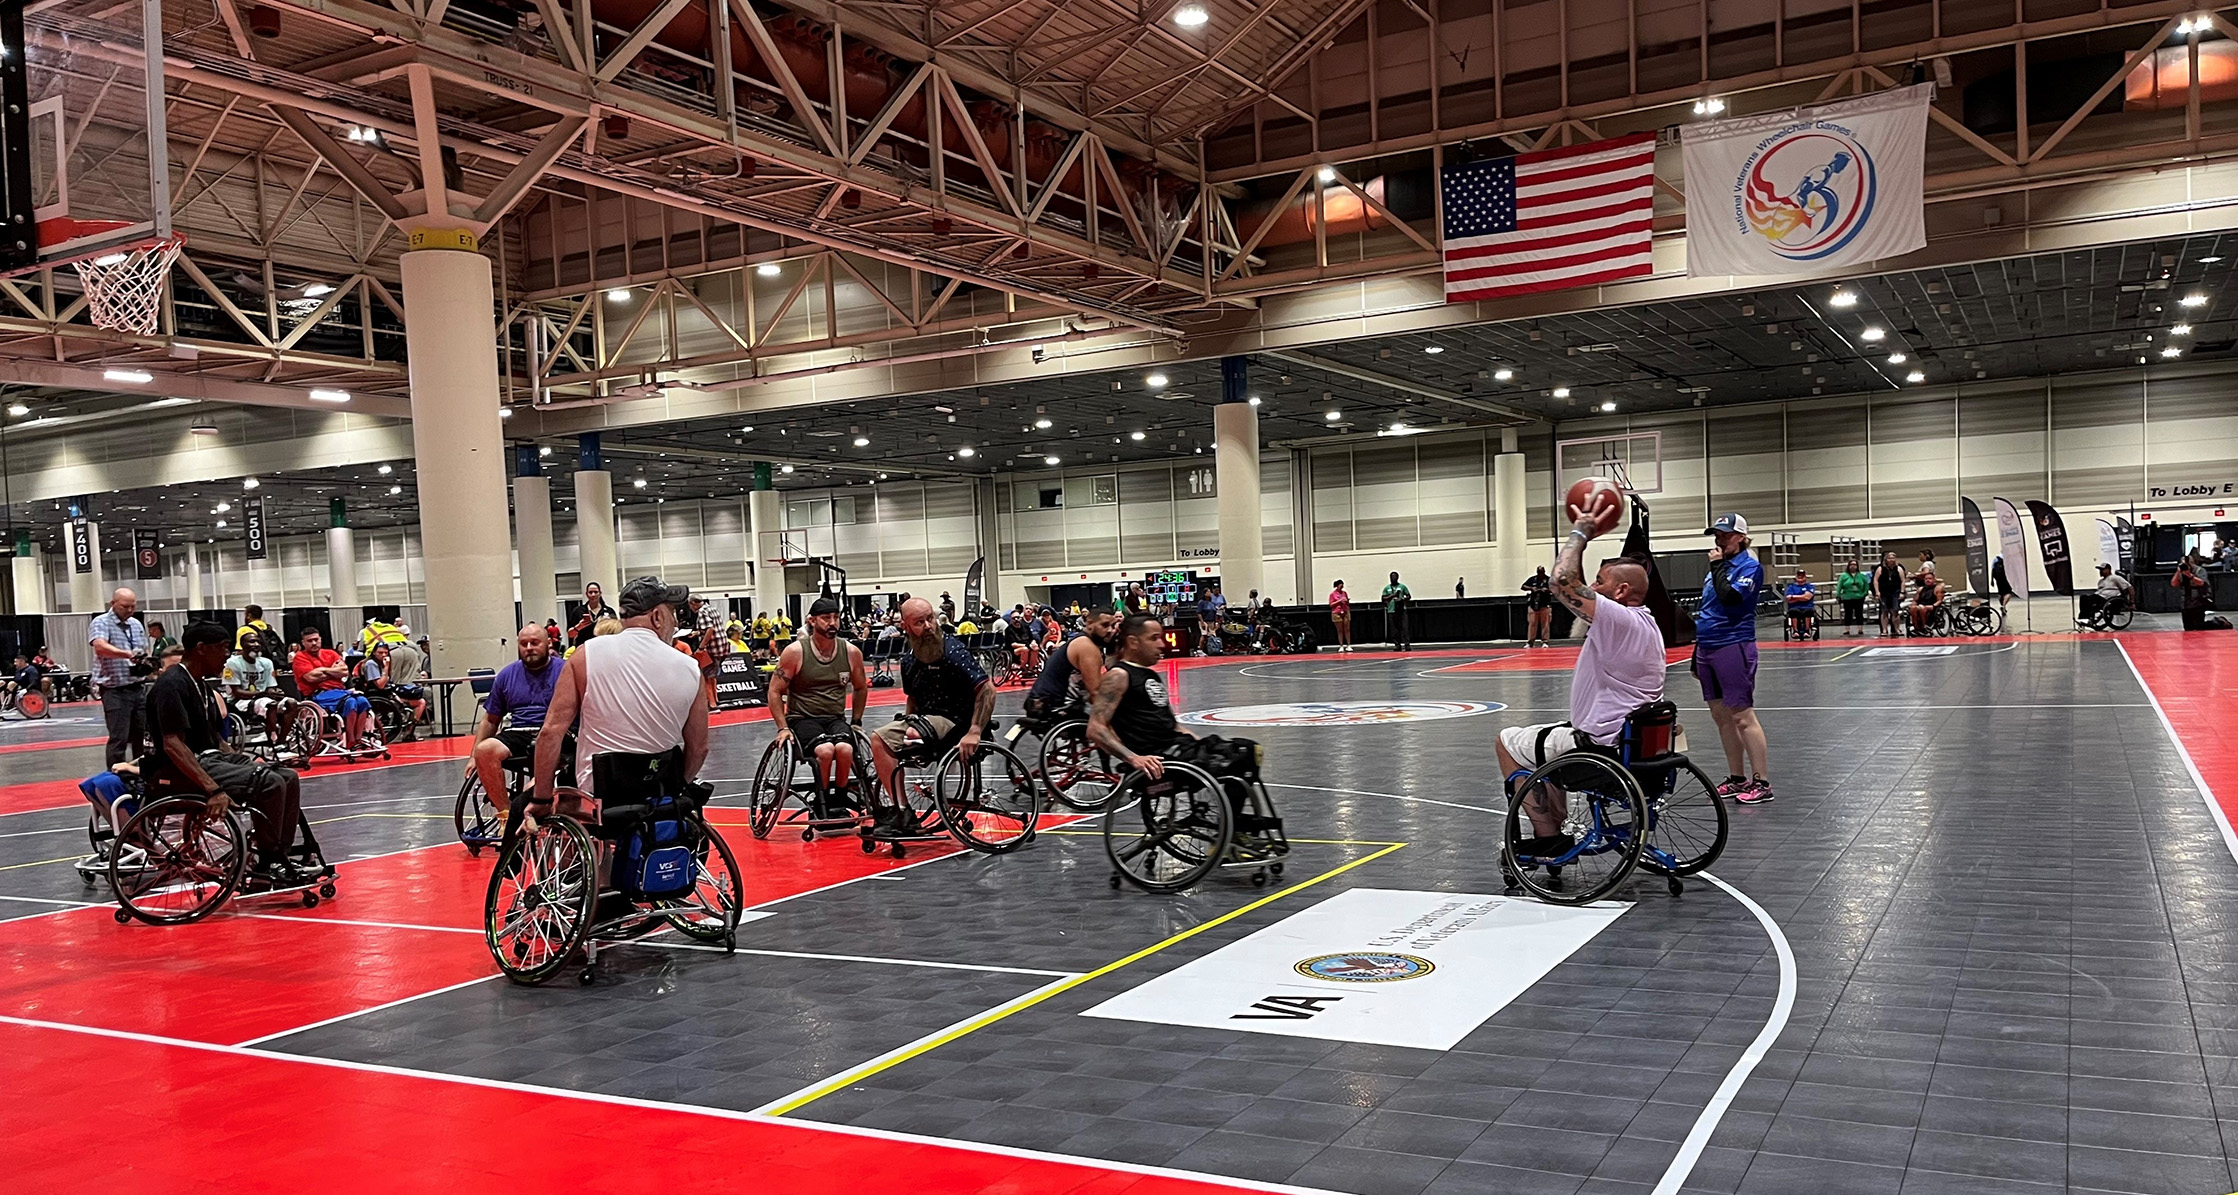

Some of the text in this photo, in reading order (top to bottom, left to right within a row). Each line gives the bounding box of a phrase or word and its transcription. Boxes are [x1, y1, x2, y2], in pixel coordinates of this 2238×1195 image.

[1733, 120, 1852, 236] National Veterans Wheelchair Games
[2150, 483, 2235, 498] To Lobby E
[248, 516, 262, 551] 500
[76, 533, 88, 565] 400
[1180, 548, 1220, 558] To Lobby
[144, 551, 153, 565] 5
[1158, 573, 1185, 584] 24:36
[1165, 632, 1177, 647] 4
[721, 663, 748, 673] GAMES
[716, 680, 758, 693] SKETBALL
[1229, 995, 1346, 1020] VA
